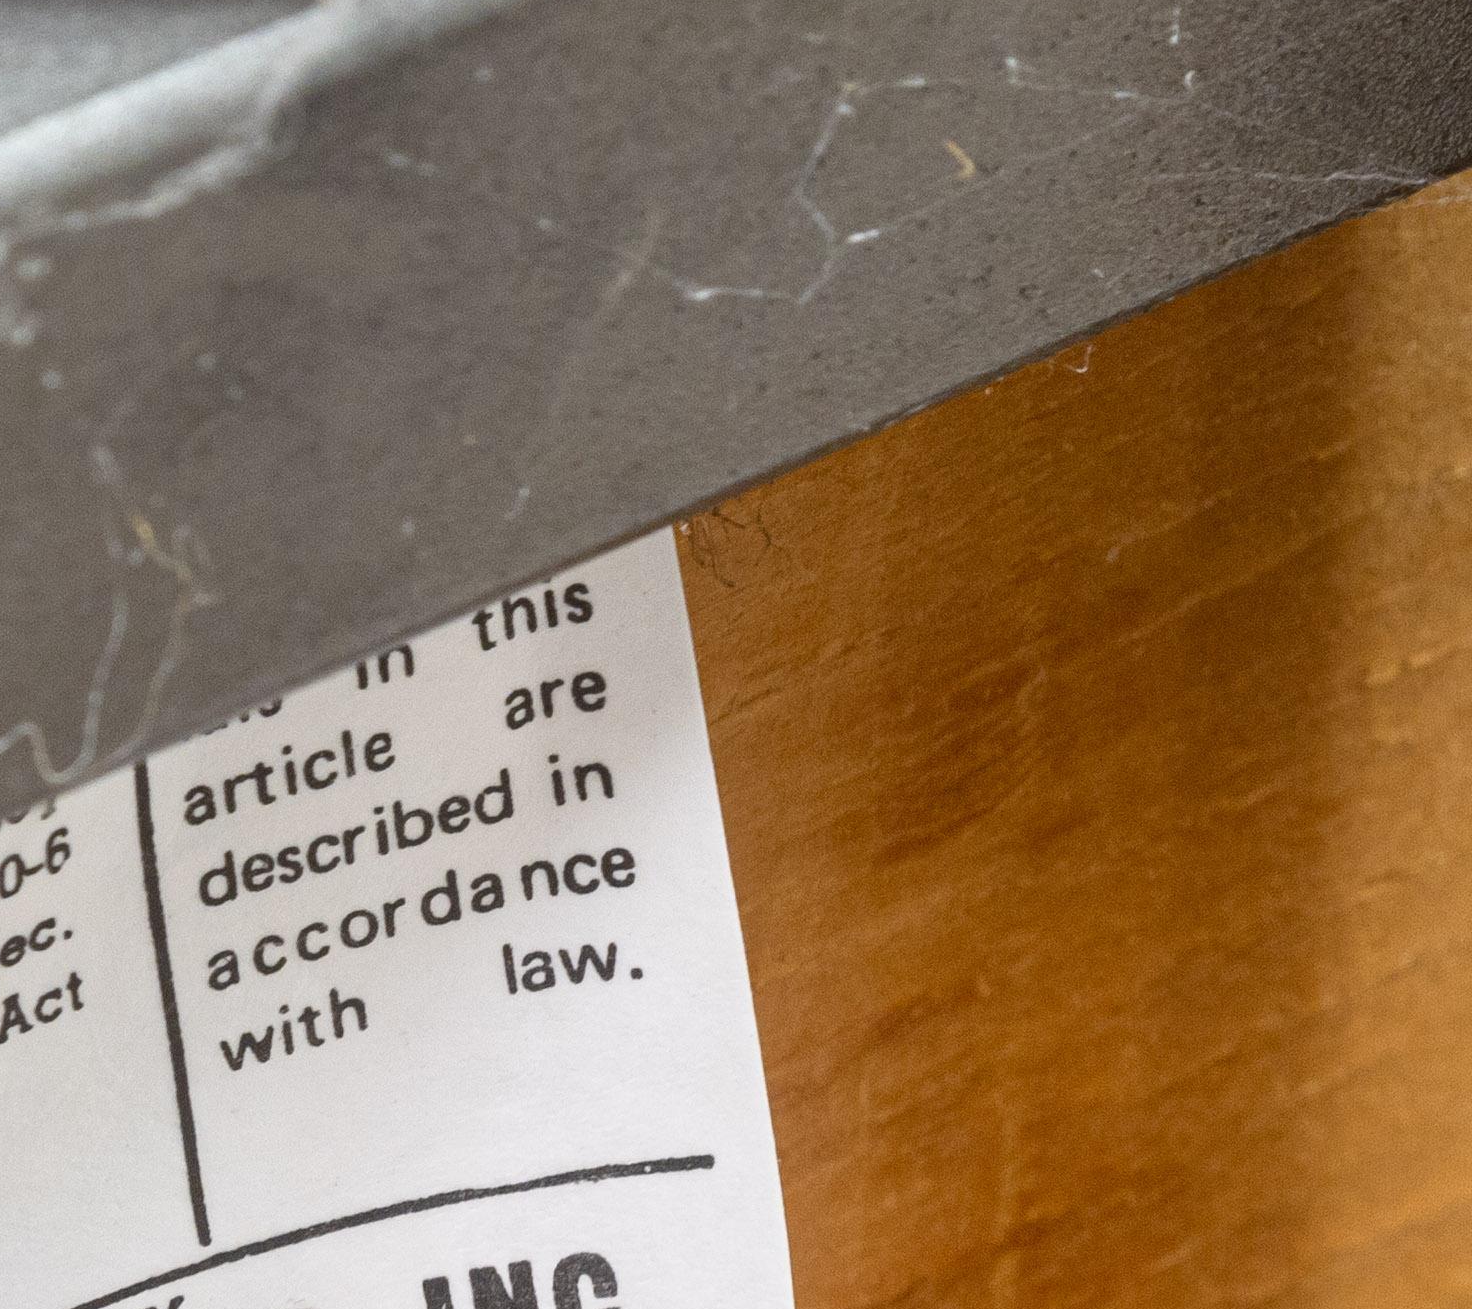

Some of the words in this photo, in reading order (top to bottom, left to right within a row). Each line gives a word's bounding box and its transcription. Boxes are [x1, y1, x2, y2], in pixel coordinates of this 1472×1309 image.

[472, 579, 594, 652] this
[183, 730, 396, 827] article
[504, 669, 607, 731] are
[198, 768, 515, 908] described
[549, 754, 615, 808] in
[207, 847, 637, 991] accordance
[219, 988, 368, 1071] with
[502, 942, 645, 995] law.
